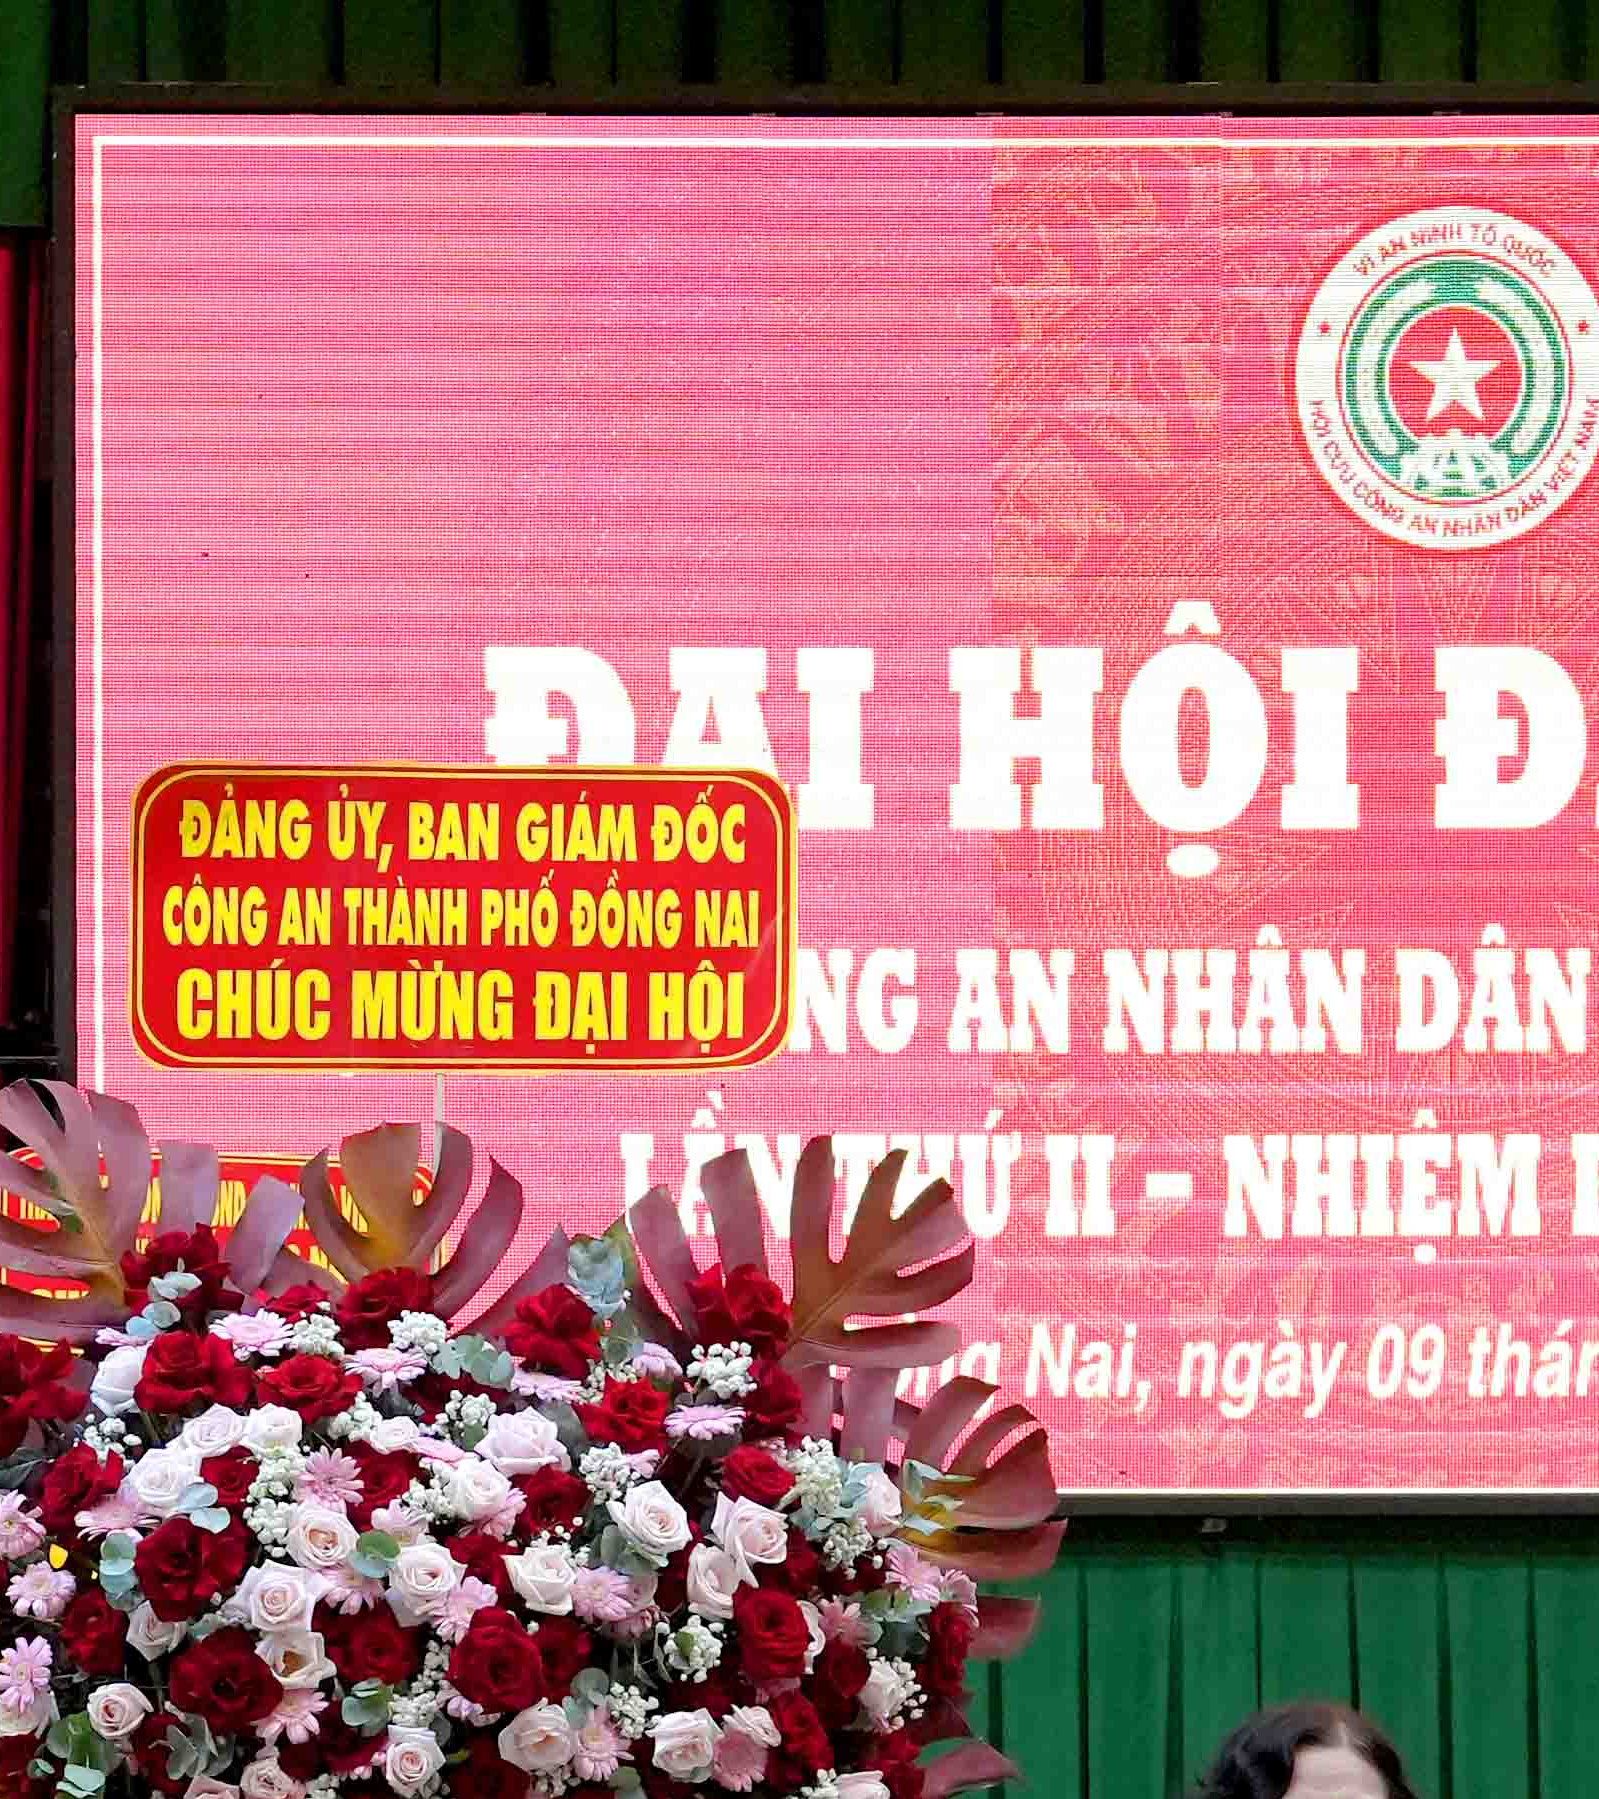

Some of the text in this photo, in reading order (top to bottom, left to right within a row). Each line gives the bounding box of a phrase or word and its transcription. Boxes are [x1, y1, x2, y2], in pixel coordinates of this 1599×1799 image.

[1406, 511, 1438, 538] AN
[949, 602, 1358, 877] HỘI
[179, 783, 746, 874] ĐẢNG ỦY, BAN GIÁM ĐỐC
[162, 868, 759, 948] CÔNG AN THÀNH PHỐ ĐỒNG NAI
[176, 958, 744, 1054] CHÚC MỪNG ĐẠI HỘI
[786, 948, 919, 1053] NG
[948, 949, 1076, 1053] AN
[1103, 923, 1365, 1053] NHÂN
[1395, 923, 1591, 1053] DÂN
[1044, 1134, 1115, 1238] II
[1145, 1173, 1193, 1205] -
[1222, 1108, 1541, 1264] NHIỆM
[1025, 1321, 1152, 1413] Nai,
[1177, 1317, 1348, 1419] ngày
[1366, 1323, 1445, 1400] 09
